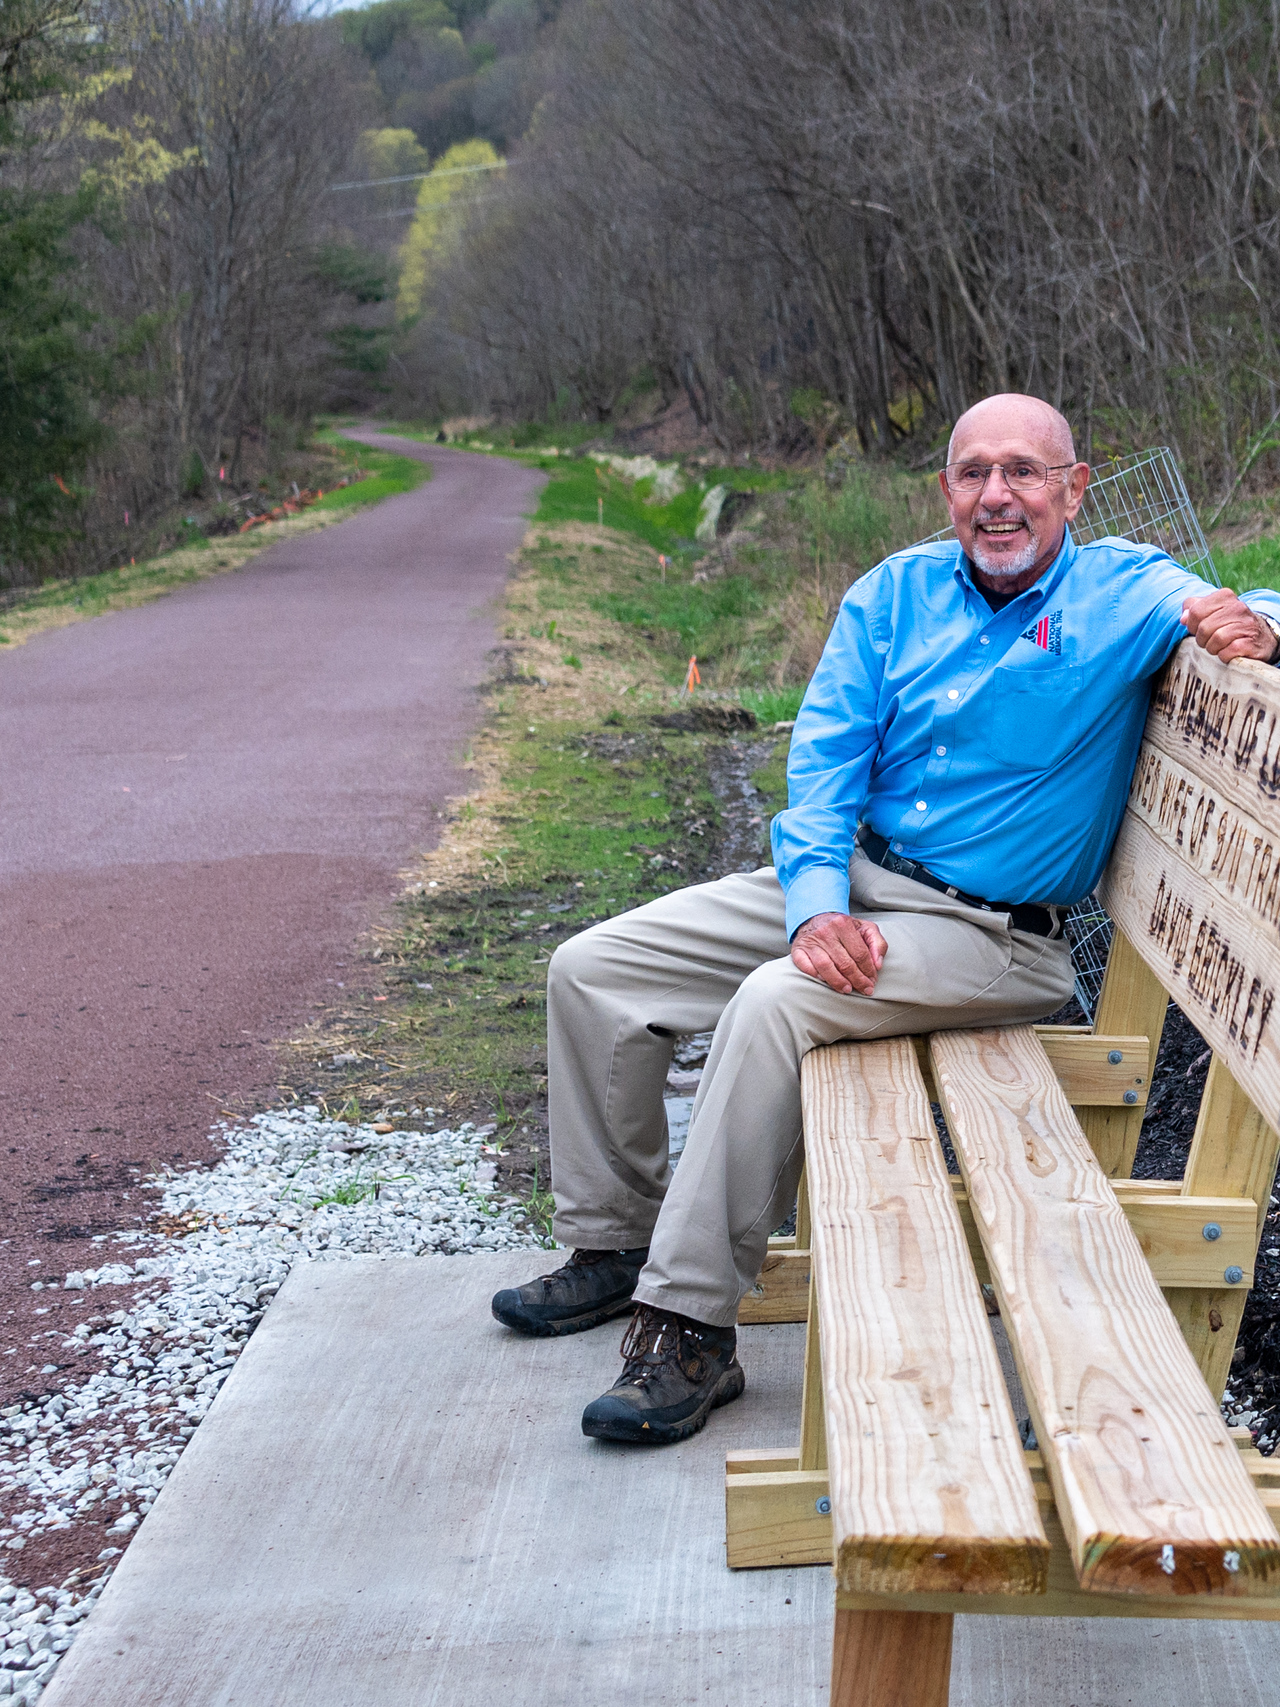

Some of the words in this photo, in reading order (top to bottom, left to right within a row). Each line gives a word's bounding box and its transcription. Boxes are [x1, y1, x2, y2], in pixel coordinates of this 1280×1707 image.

[1236, 703, 1266, 766] OF
[1190, 794, 1216, 856] OF
[1149, 874, 1194, 969] DAVID
[1187, 916, 1276, 1061] BRICKLEY
